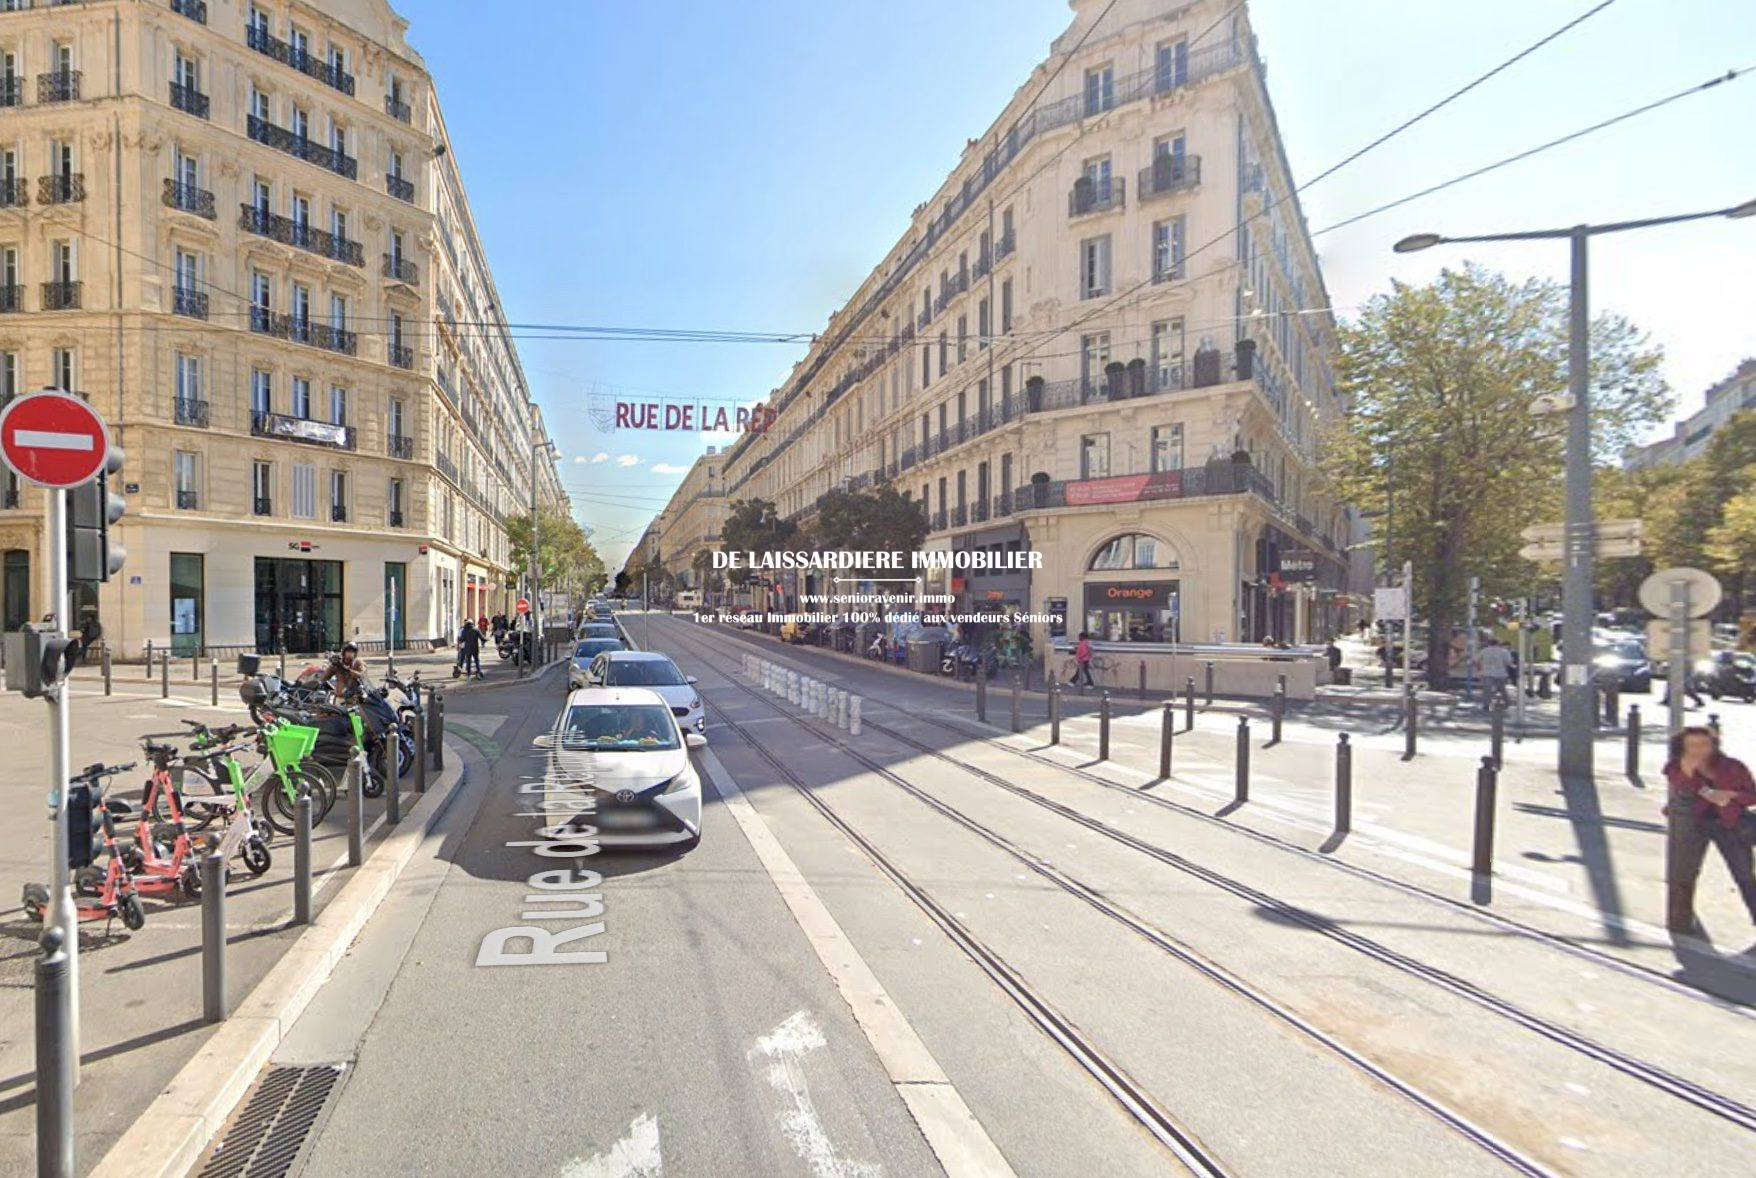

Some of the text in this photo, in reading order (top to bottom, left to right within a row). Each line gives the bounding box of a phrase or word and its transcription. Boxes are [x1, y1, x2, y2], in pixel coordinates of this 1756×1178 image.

[616, 402, 659, 429] RUE
[665, 404, 694, 431] DE
[702, 405, 729, 432] LA
[1107, 587, 1154, 600] Orange
